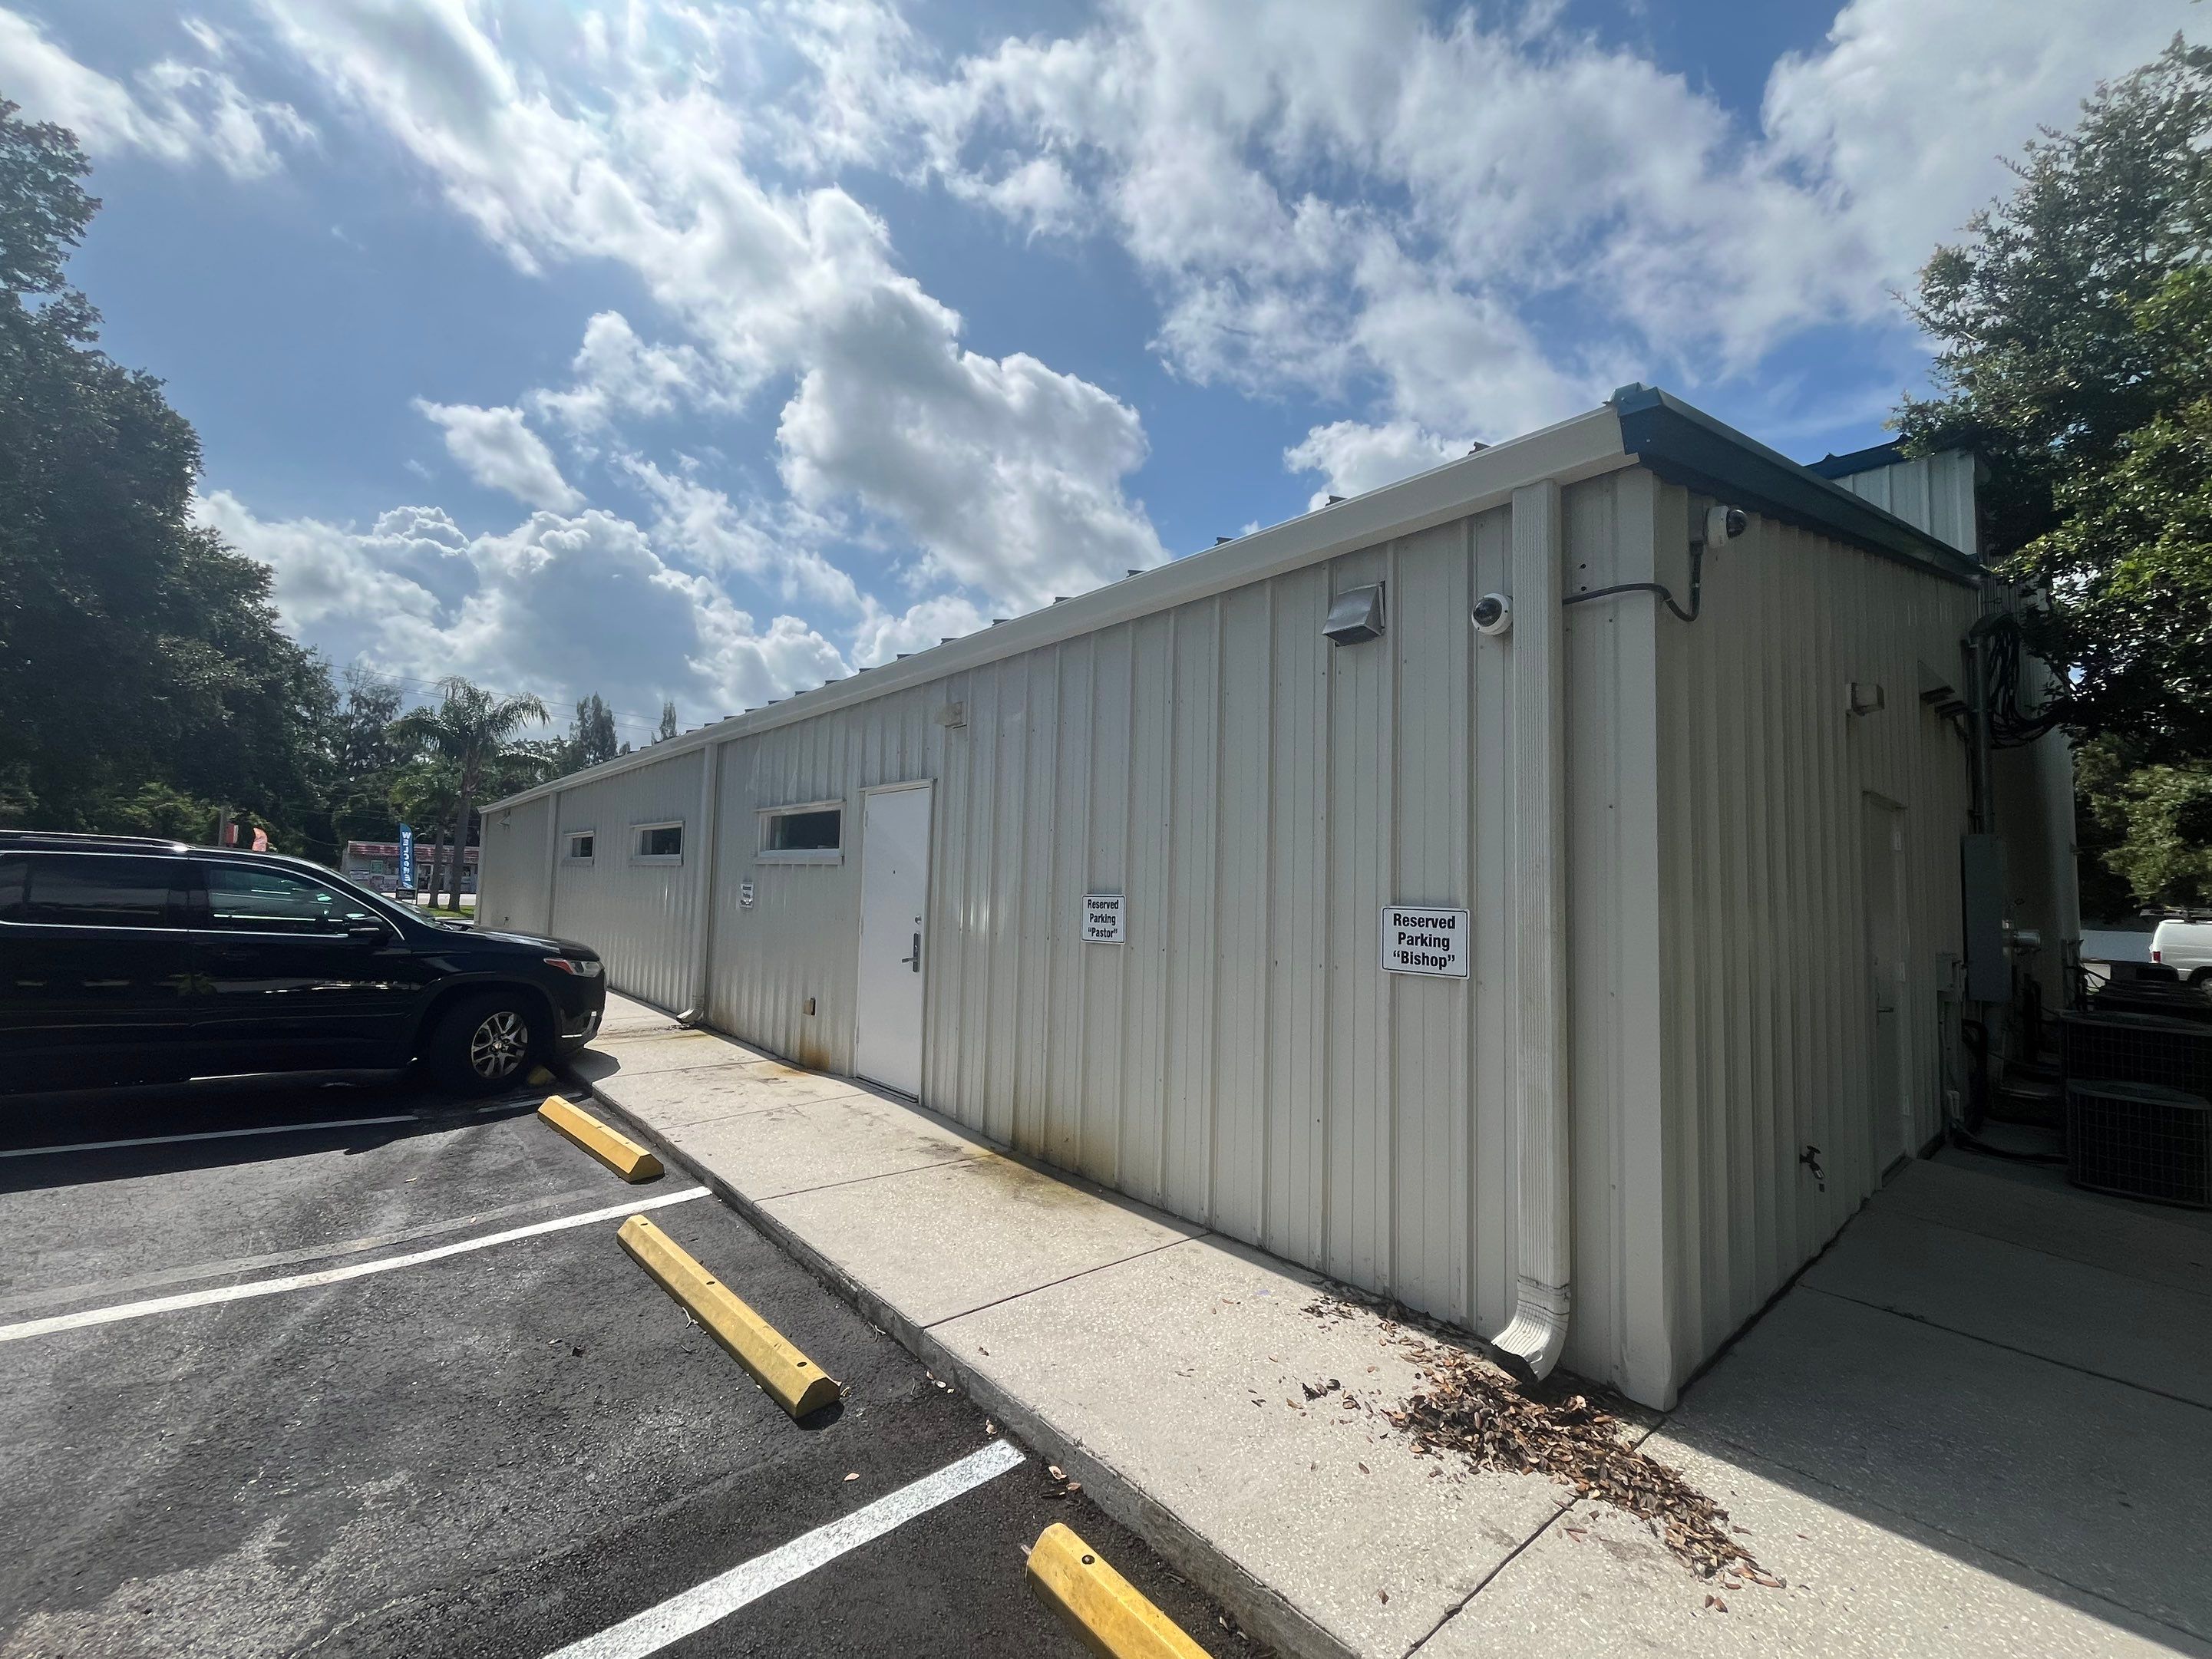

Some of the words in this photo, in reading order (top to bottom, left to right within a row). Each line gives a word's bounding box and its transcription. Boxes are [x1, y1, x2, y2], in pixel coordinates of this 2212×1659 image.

[1087, 899, 1119, 909] Reserved
[1089, 913, 1116, 926] Parking
[1393, 913, 1456, 929] Reserved
[1398, 932, 1450, 952] Parking
[1393, 950, 1455, 970] “Bishop”
